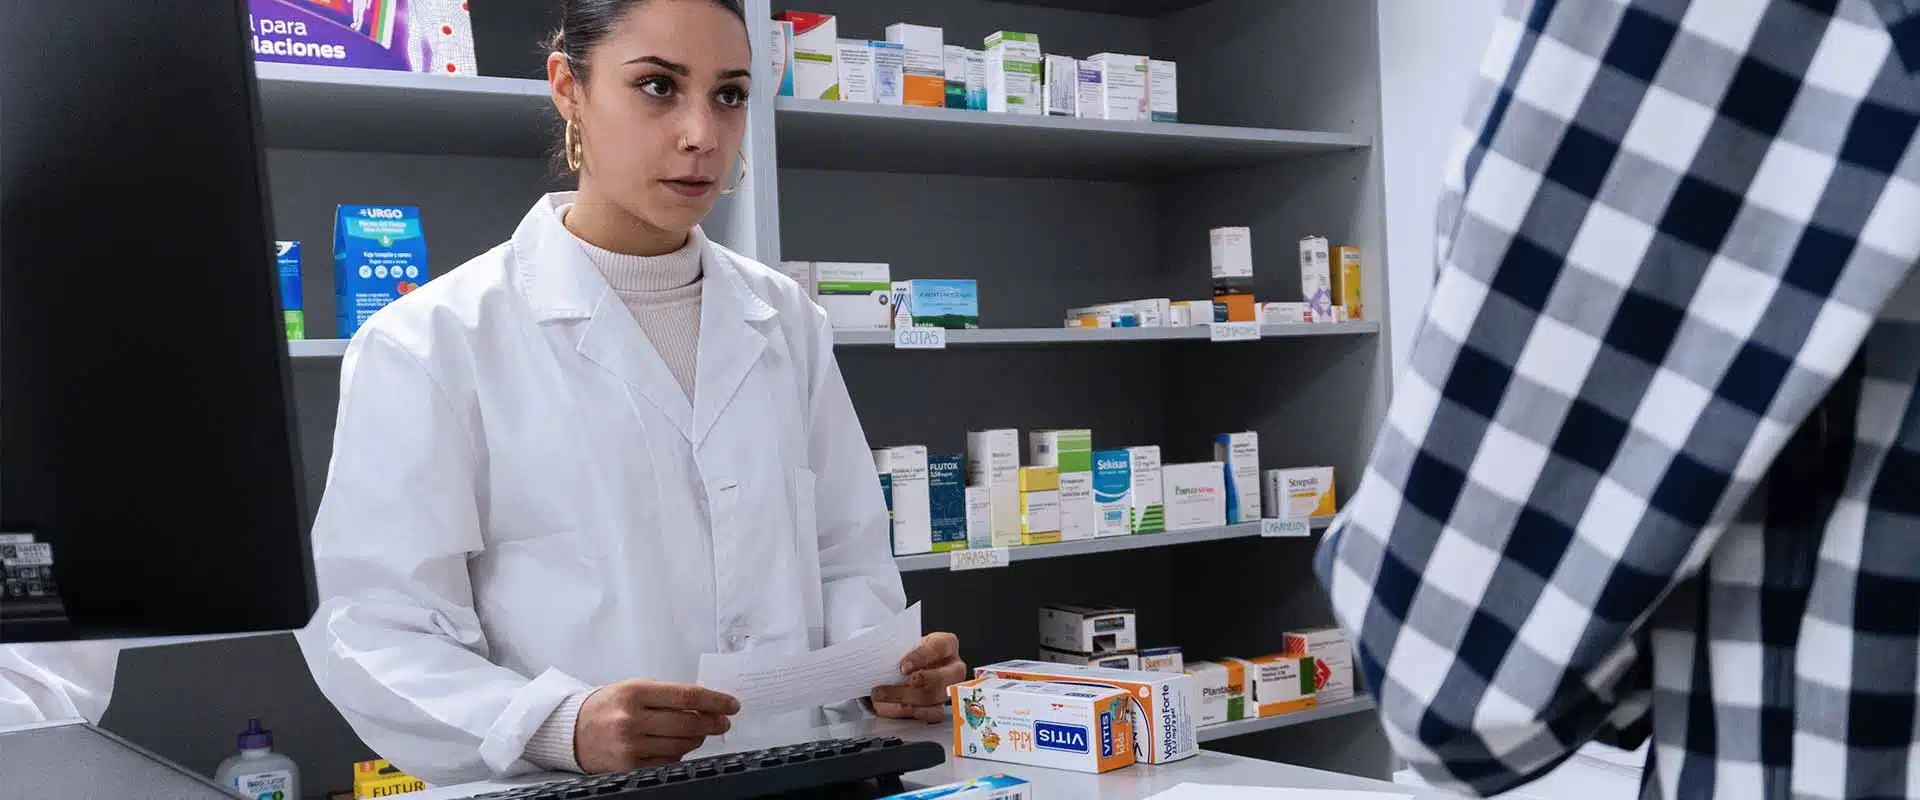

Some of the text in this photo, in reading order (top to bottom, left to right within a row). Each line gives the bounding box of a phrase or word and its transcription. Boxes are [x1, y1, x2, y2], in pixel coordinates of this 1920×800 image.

[260, 18, 307, 36] para
[367, 208, 403, 219] URGO
[900, 330, 940, 345] GOTAS
[930, 462, 958, 471] FLUTOX
[1097, 458, 1128, 470] Sekisan
[1264, 520, 1306, 533] CARAMELOS
[953, 550, 999, 568] JARABES
[1161, 684, 1172, 760] Voltadol Forte
[1008, 729, 1032, 753] kids
[1038, 729, 1084, 746] VITIS
[1102, 715, 1111, 755] VITIS
[373, 780, 425, 798] FUTUR
